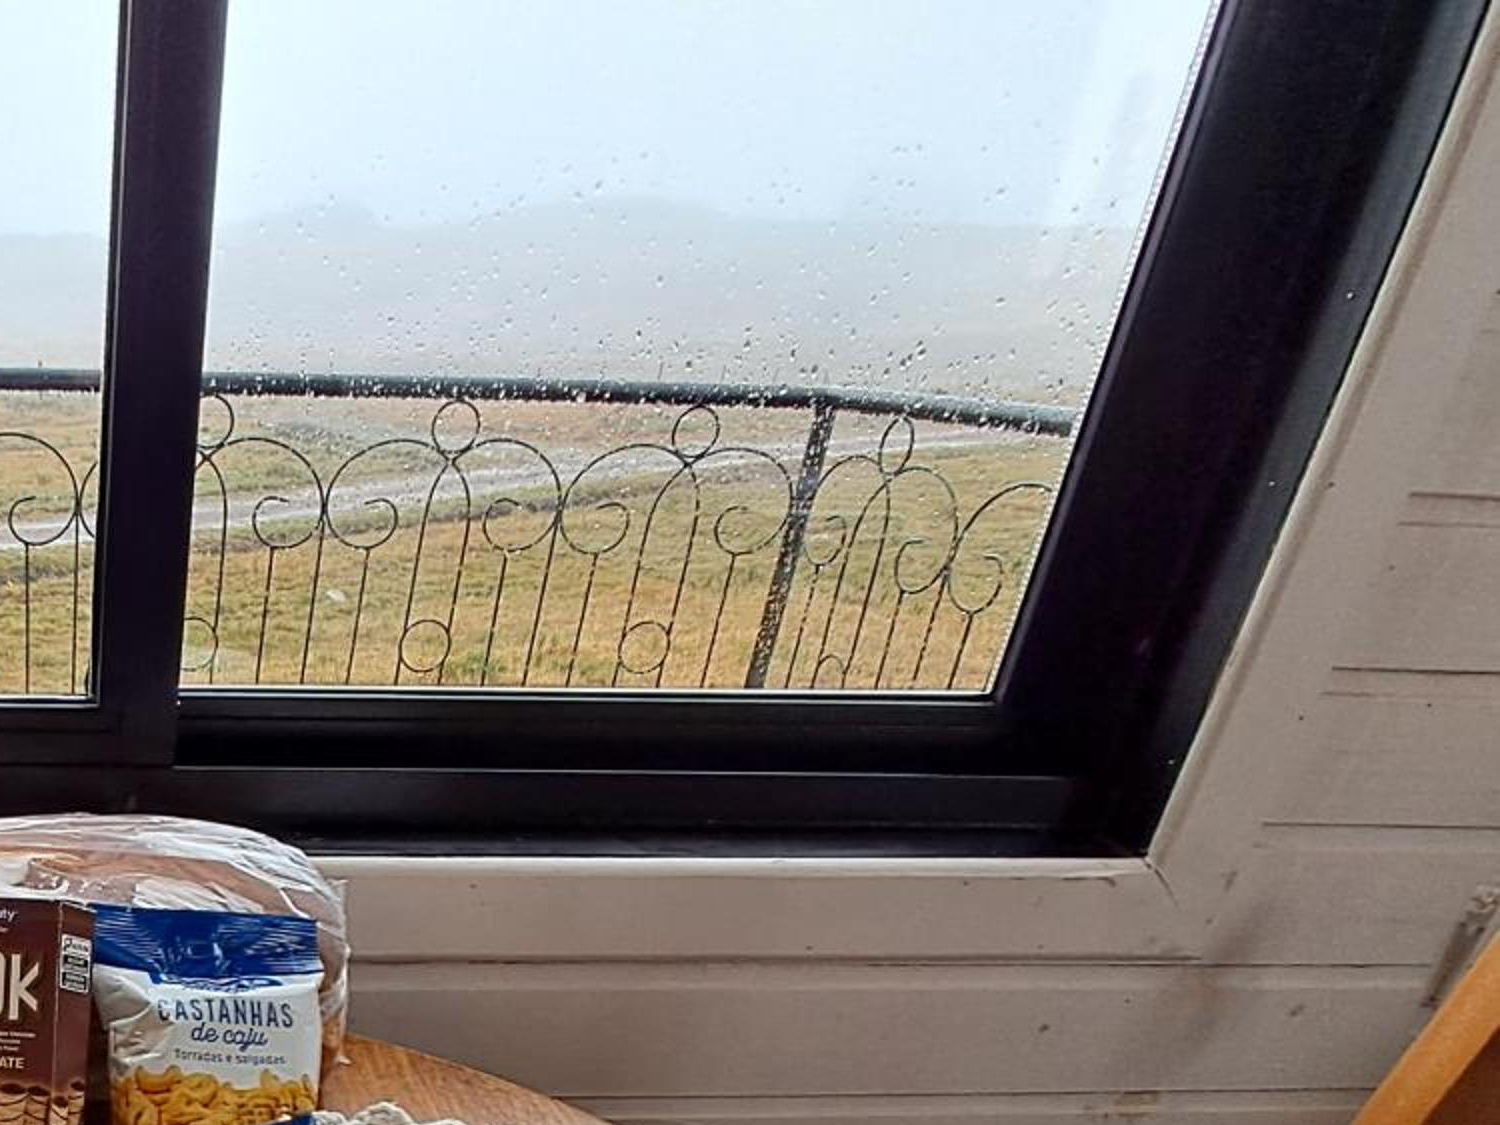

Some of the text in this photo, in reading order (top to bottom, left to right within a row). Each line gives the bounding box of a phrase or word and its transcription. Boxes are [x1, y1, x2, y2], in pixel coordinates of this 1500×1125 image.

[157, 998, 294, 1029] CASTANHAS
[190, 1023, 269, 1052] de caju
[174, 1047, 223, 1064] Torradas
[234, 1053, 287, 1067] salgadas
